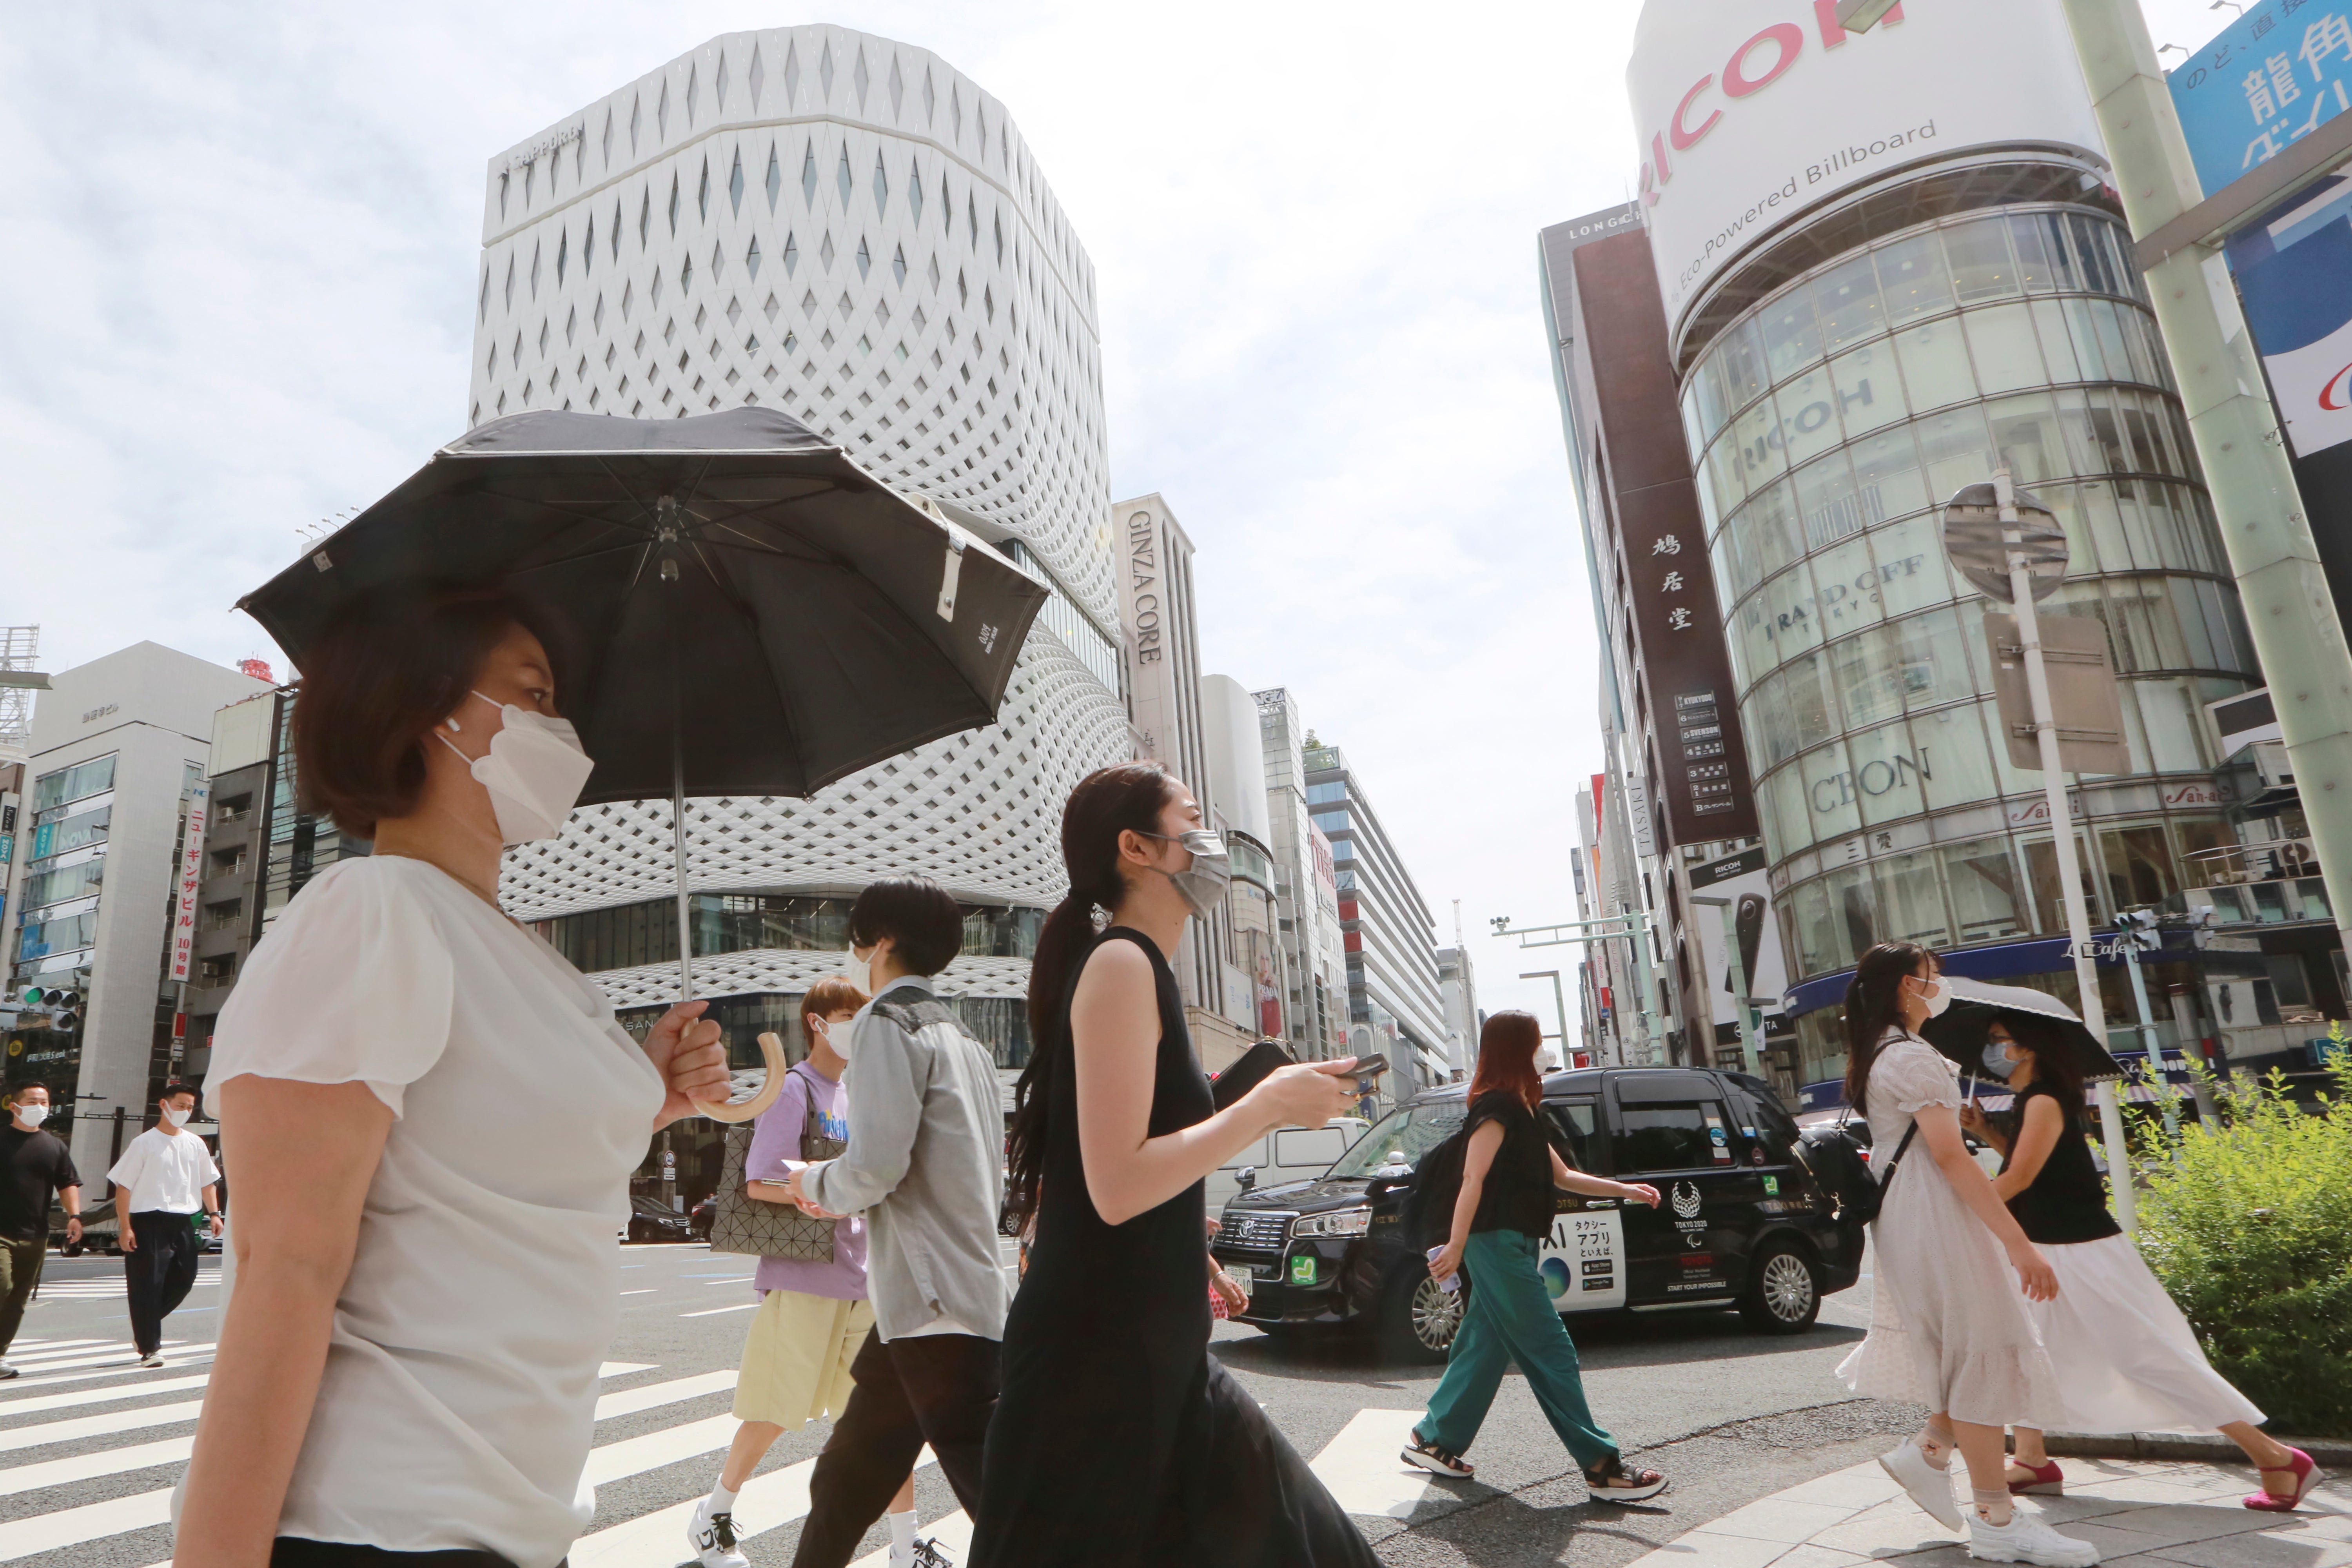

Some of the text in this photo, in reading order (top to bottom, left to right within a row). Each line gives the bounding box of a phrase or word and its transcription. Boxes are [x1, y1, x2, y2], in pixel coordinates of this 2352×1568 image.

[1680, 119, 1936, 290] Eco-Powered Billboard
[1129, 510, 1161, 665] GINZA CORE
[1690, 726, 1719, 737] SVENSON
[1631, 787, 1650, 848] TASAKI
[0, 838, 10, 860] NOVA
[39, 828, 48, 856] NOVA
[61, 828, 93, 850] NOVA
[1715, 860, 1741, 874] RICOH
[175, 809, 204, 976] ニューギンザビル 10号館
[1257, 983, 1279, 998] PRADA
[1575, 1221, 1607, 1230] タクシー
[1578, 1231, 1610, 1246] アプリ
[1581, 1246, 1614, 1257] といえば、
